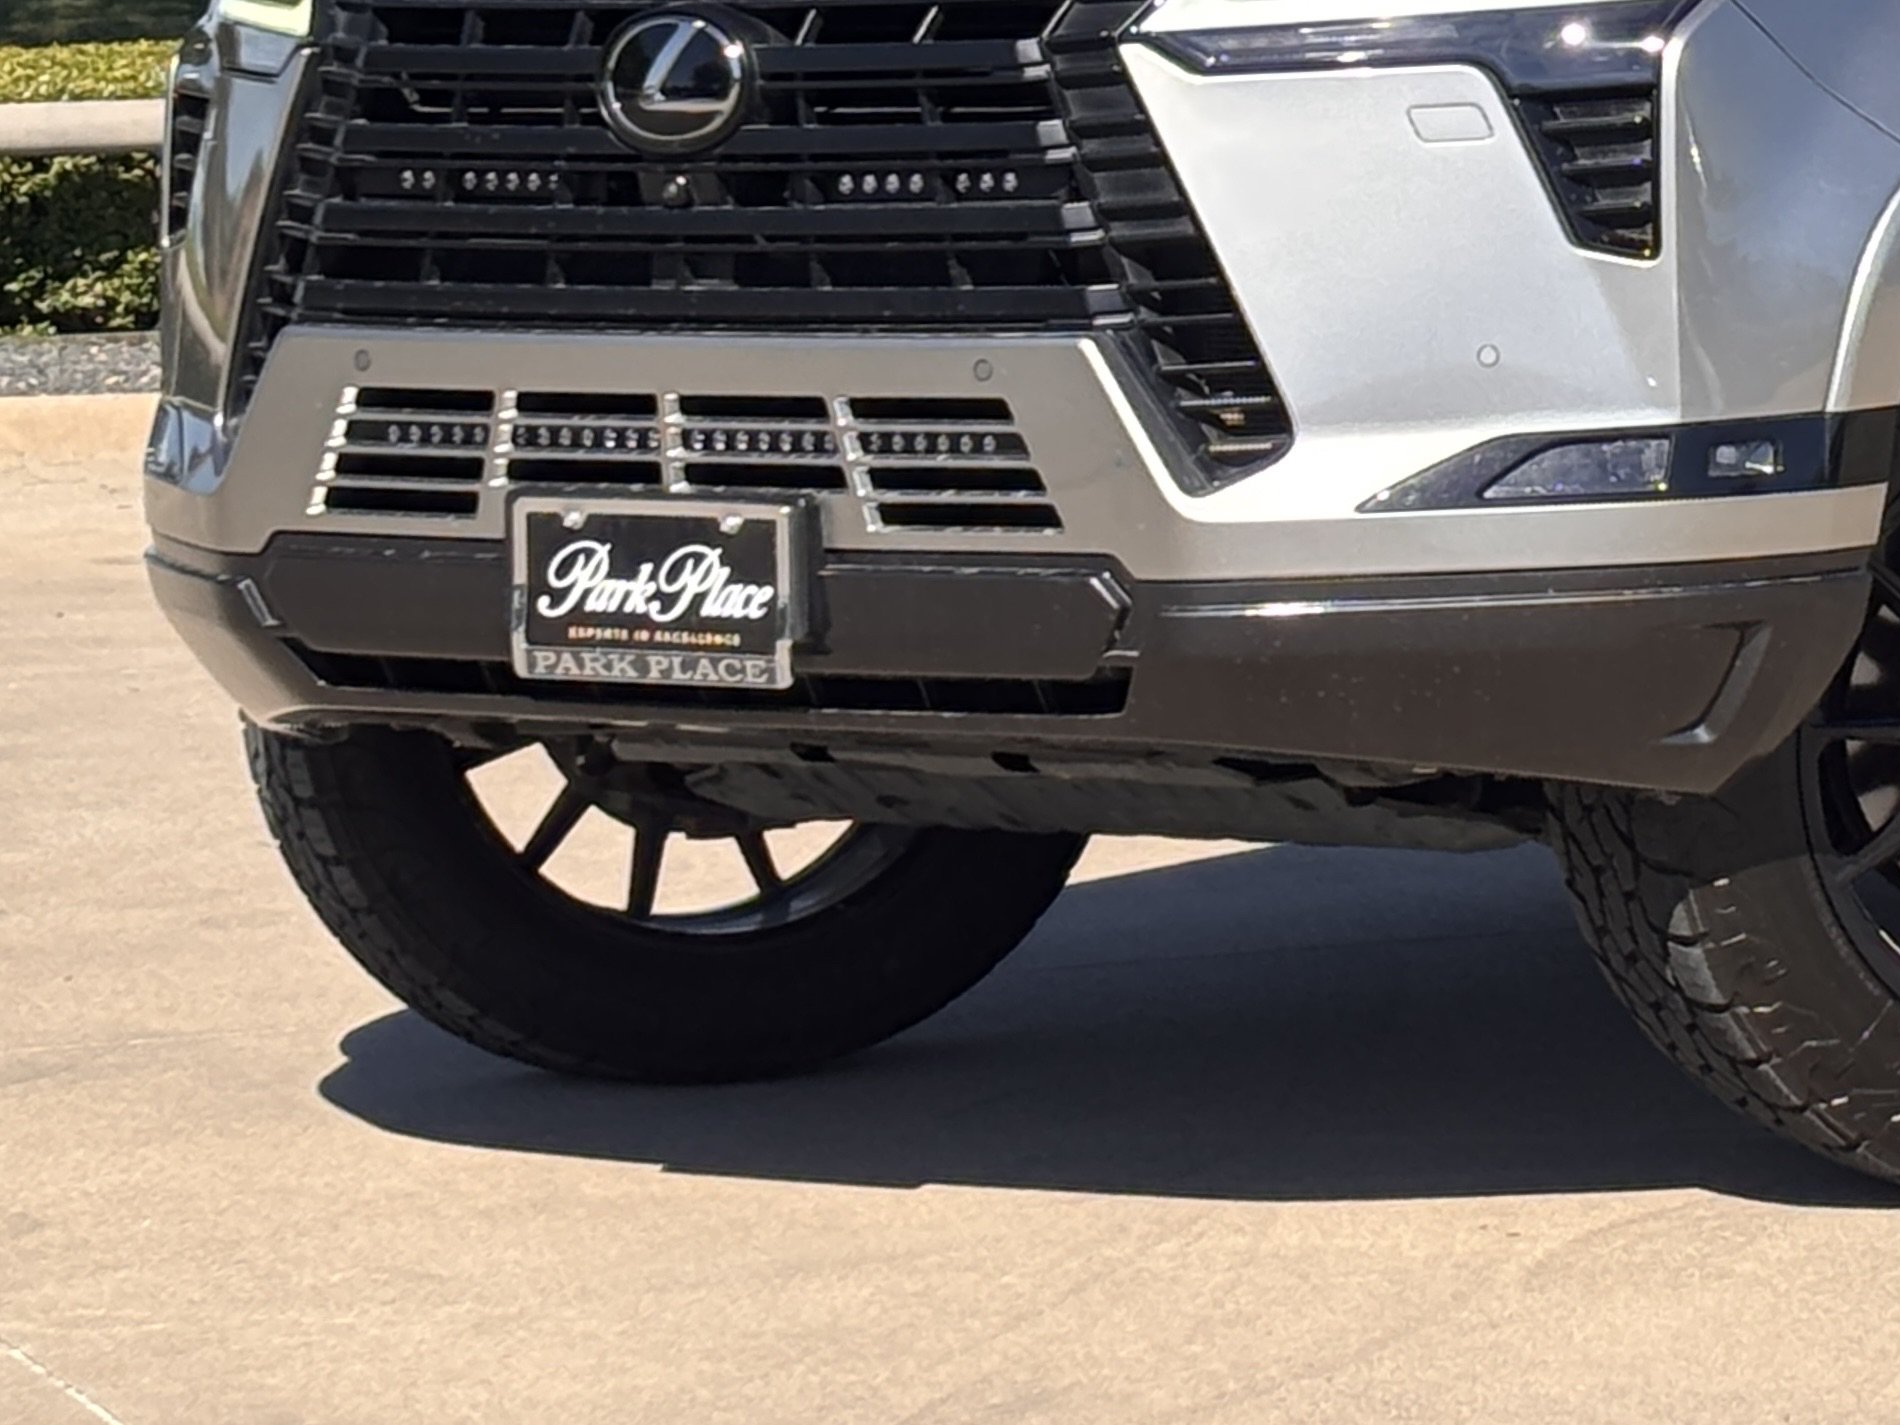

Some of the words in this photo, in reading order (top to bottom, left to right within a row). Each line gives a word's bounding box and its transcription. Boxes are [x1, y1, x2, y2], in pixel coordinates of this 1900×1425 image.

[536, 539, 658, 618] Park
[648, 544, 775, 623] Place
[532, 650, 639, 678] PARK
[646, 655, 771, 684] PLACE
